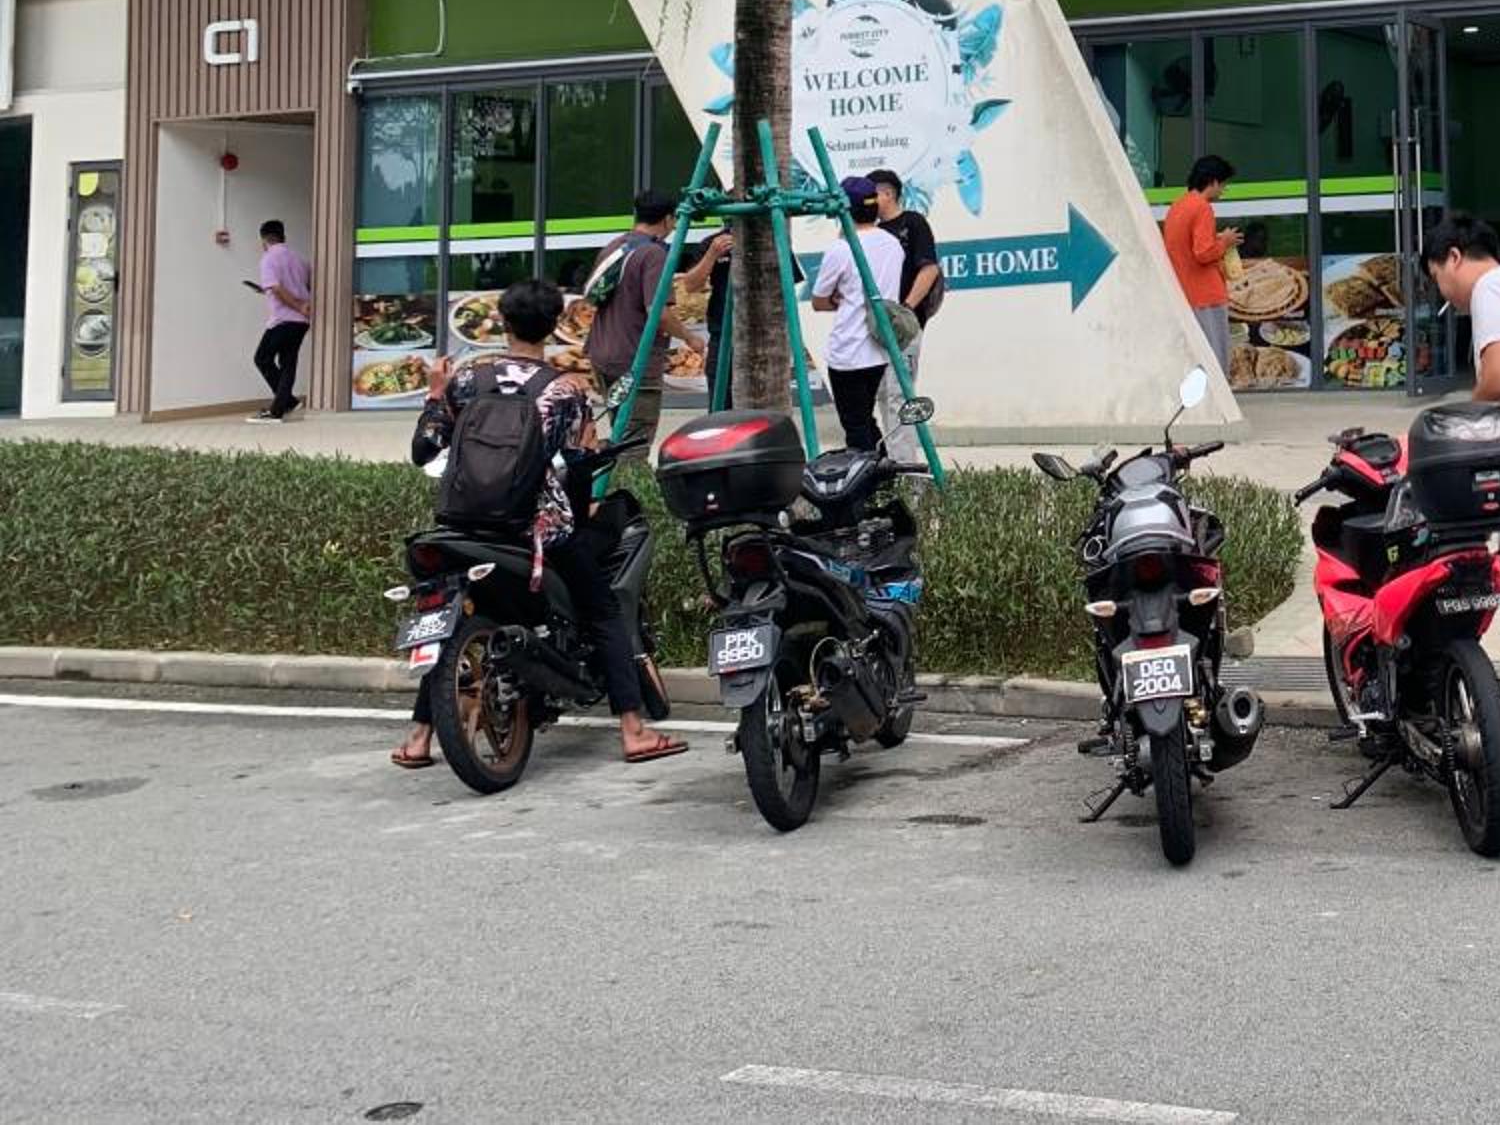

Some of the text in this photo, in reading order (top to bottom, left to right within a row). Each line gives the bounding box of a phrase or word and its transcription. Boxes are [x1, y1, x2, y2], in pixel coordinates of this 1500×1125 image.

[804, 62, 929, 92] WELCOME
[830, 93, 903, 117] HOME
[975, 246, 1059, 276] HOME
[725, 630, 758, 652] PPK
[1133, 674, 1183, 697] 2004
